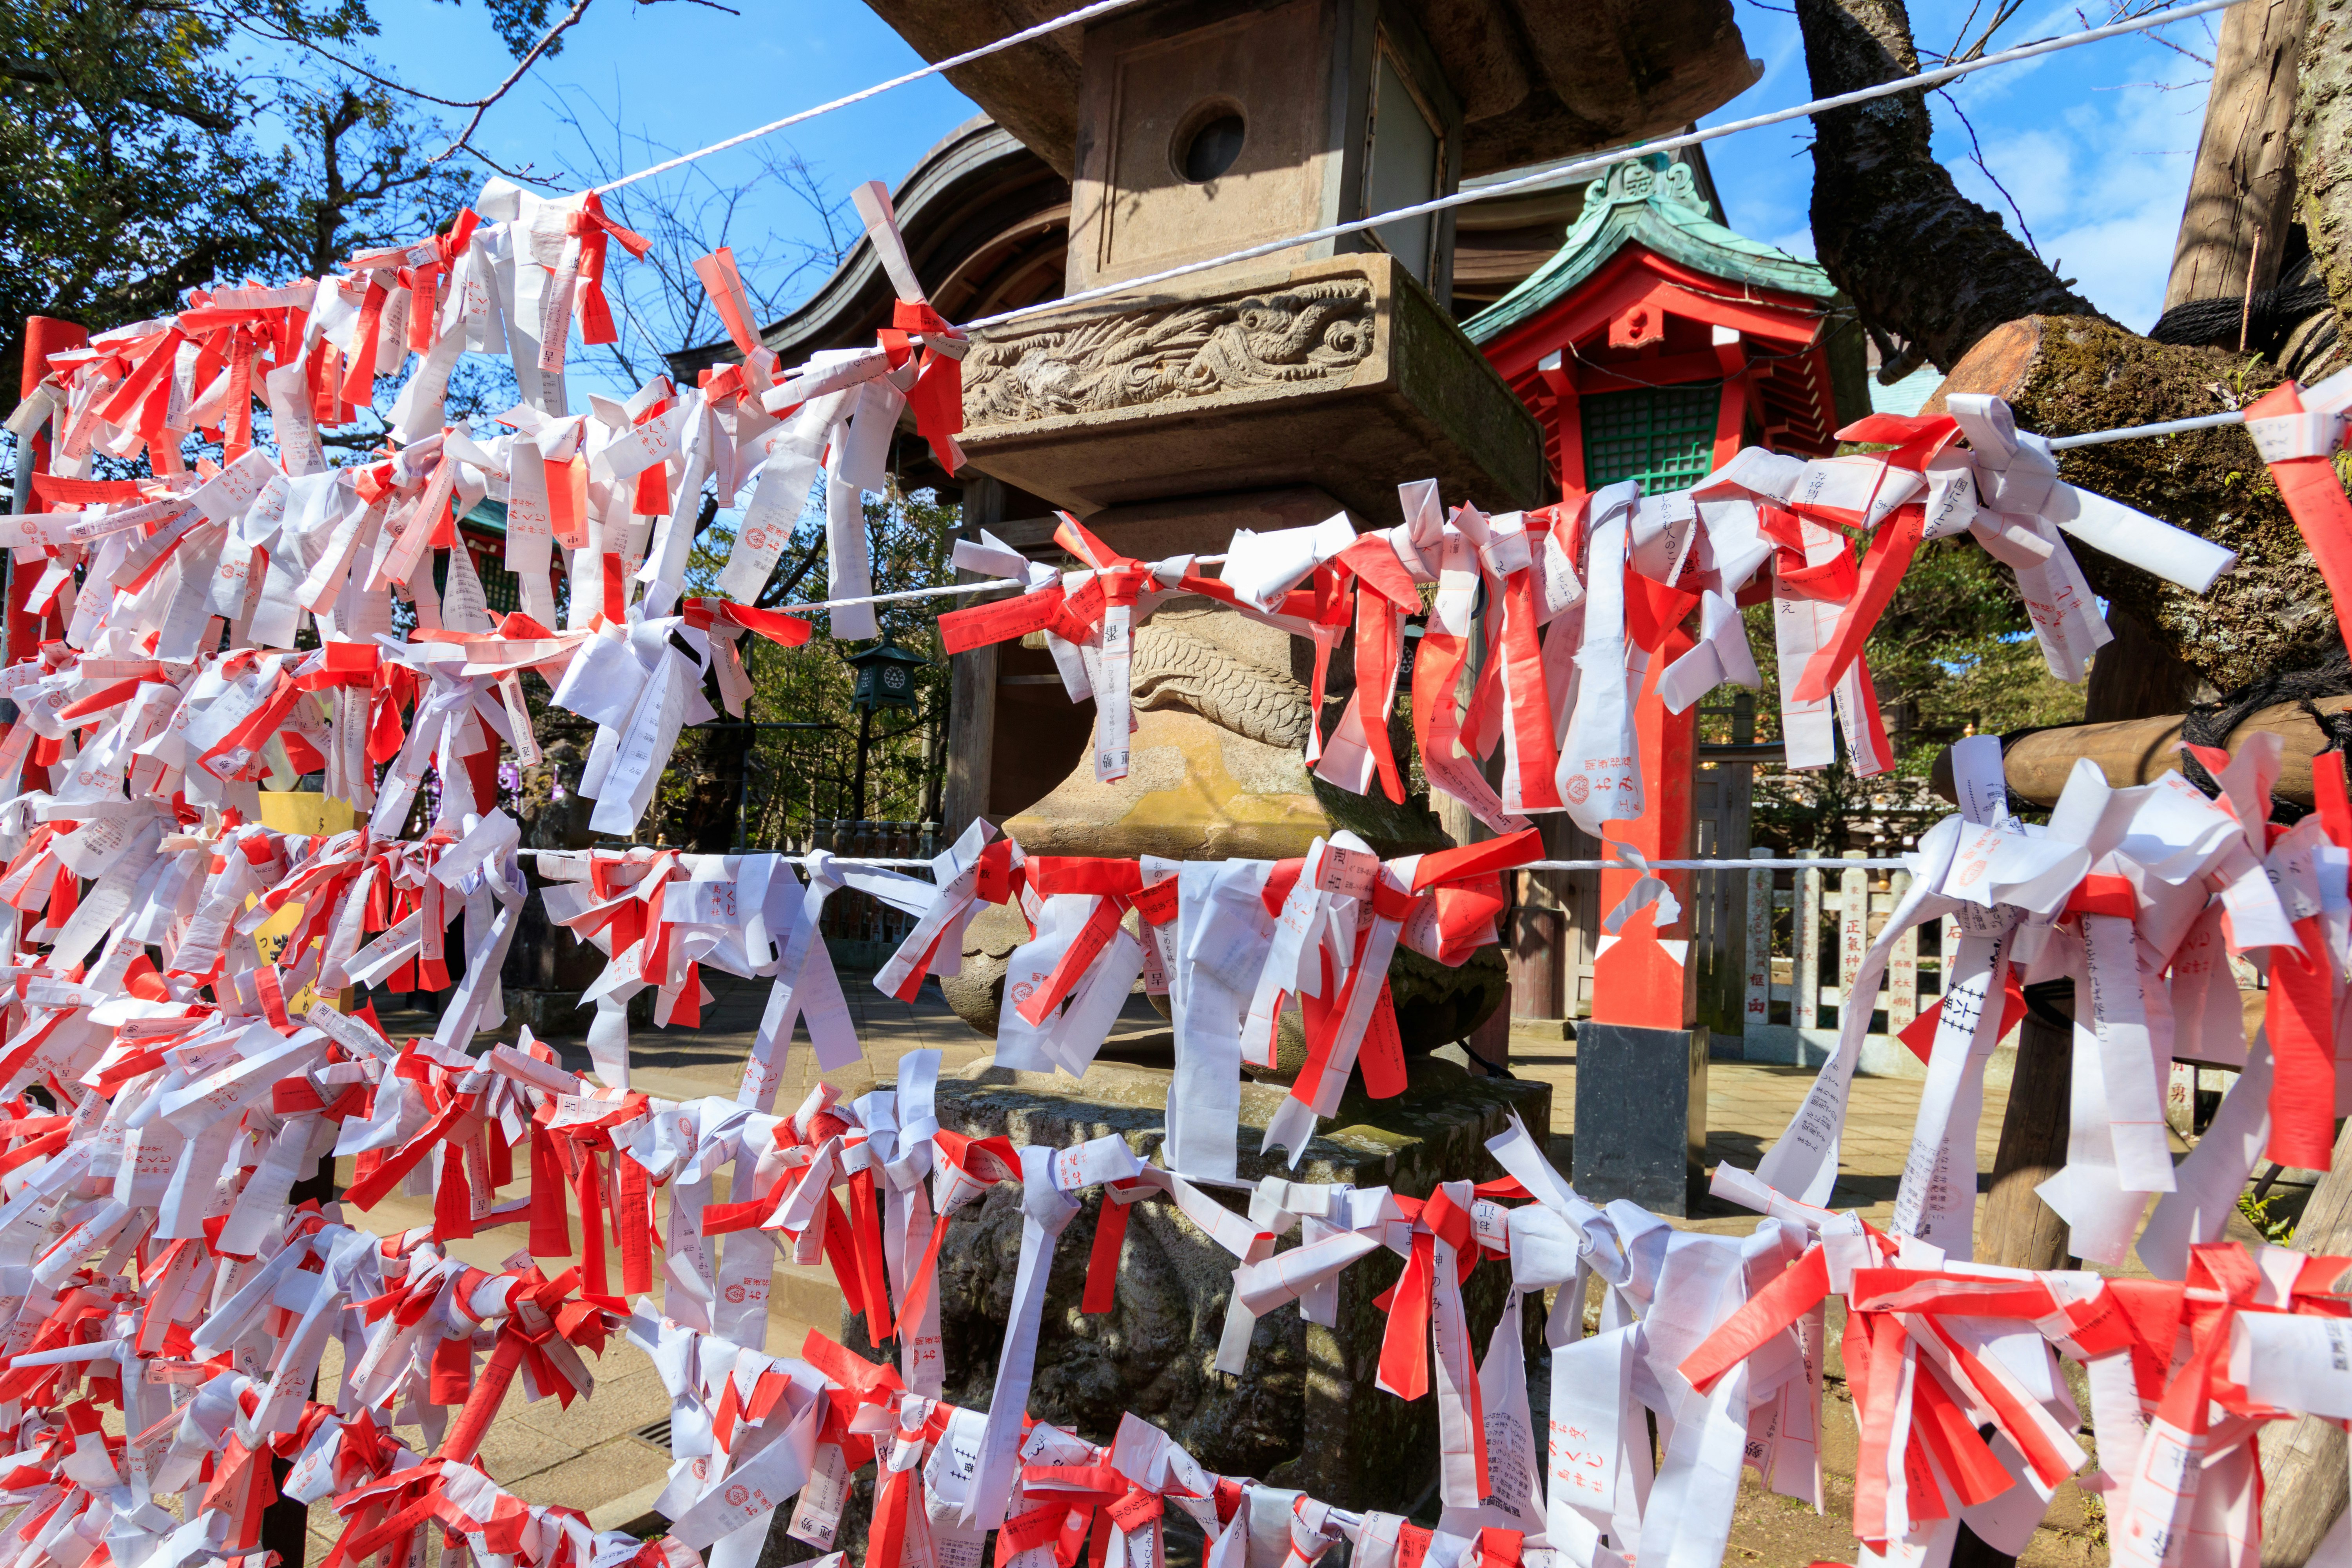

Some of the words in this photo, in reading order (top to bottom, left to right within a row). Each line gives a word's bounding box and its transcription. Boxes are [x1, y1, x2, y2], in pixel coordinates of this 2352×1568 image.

[649, 424, 667, 447] くじ
[225, 468, 251, 494] みくじ
[260, 493, 285, 512] みくじ
[509, 509, 546, 522] みくじ
[31, 536, 39, 544] お
[767, 541, 779, 552] お
[1105, 624, 1118, 642] 番
[522, 746, 530, 758] 運
[248, 762, 255, 771] 中
[1584, 755, 1633, 772] 開運招福
[1496, 811, 1512, 826] 吉
[940, 865, 976, 898] みこえ
[1328, 873, 1341, 891] 吉
[711, 884, 721, 916] 島神社
[1151, 973, 1164, 986] 吉
[318, 1004, 330, 1016] 運
[36, 1065, 47, 1074] お
[745, 1069, 778, 1084] みくじ
[1797, 1136, 1818, 1152] ません
[1480, 1204, 1495, 1220] 江
[1479, 1221, 1490, 1232] お
[744, 1277, 770, 1287] 開運招
[748, 1291, 762, 1301] お
[1432, 1252, 1444, 1355] 神のみこえ
[915, 1336, 941, 1346] 開運招
[922, 1350, 936, 1360] お
[1548, 1439, 1604, 1468] みくじ
[296, 1470, 304, 1481] お
[964, 1462, 975, 1474] 番
[744, 1504, 758, 1516] お
[800, 1517, 833, 1541] 運勢
[1403, 1539, 1410, 1558] 失物
[1419, 1543, 1427, 1559] 待人
